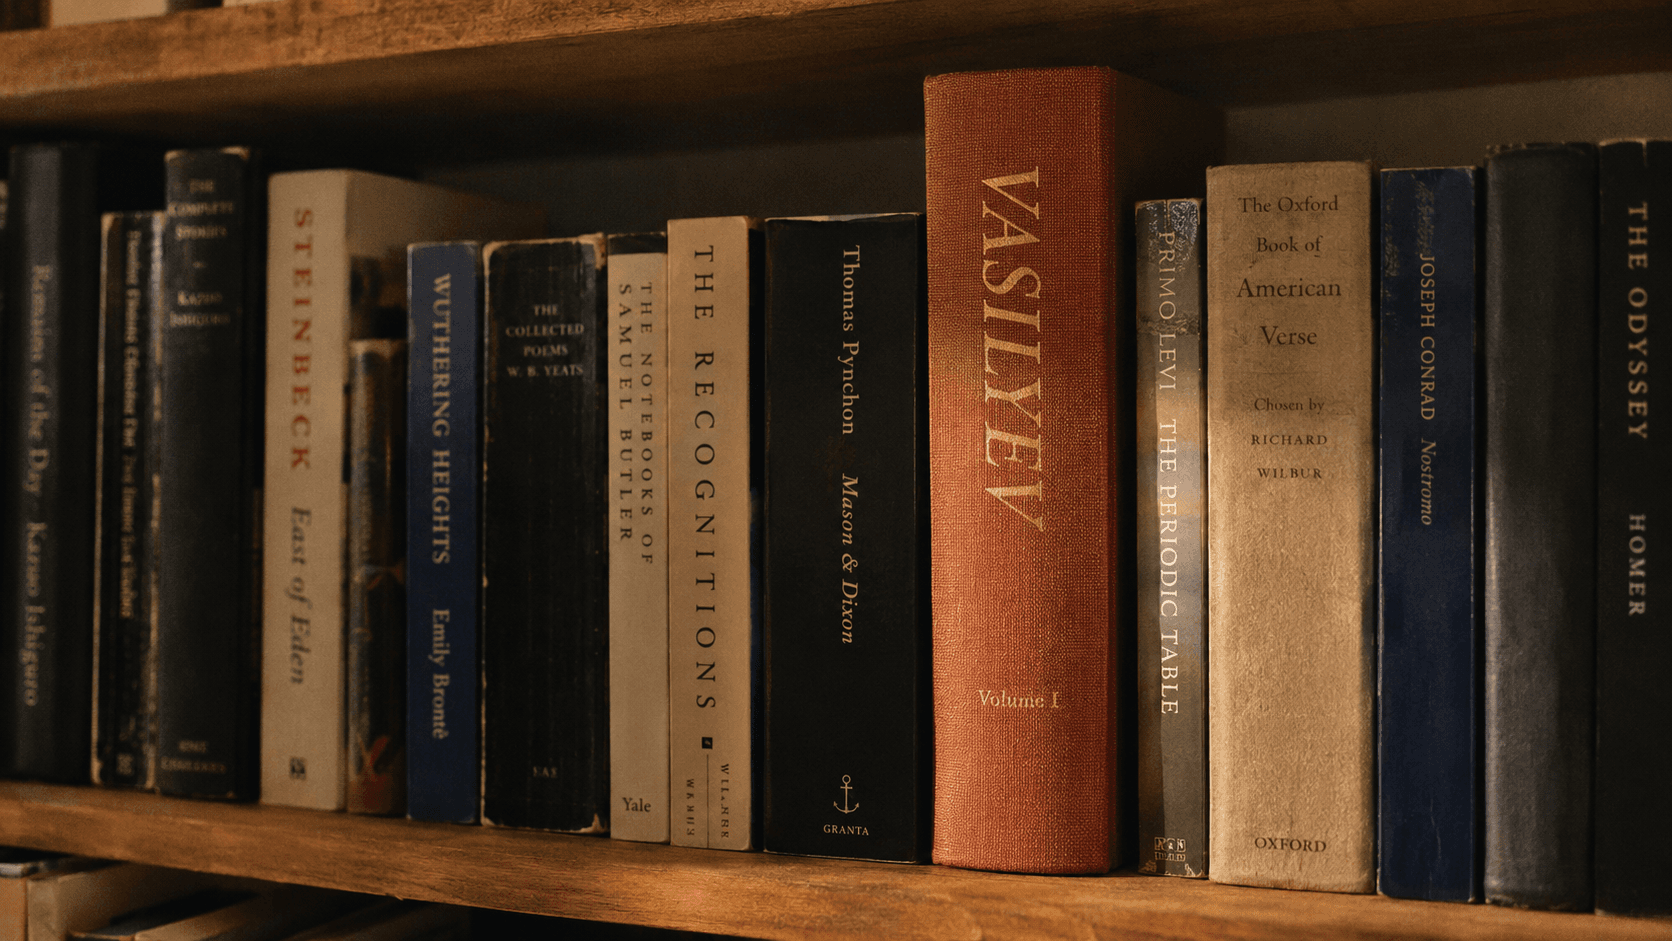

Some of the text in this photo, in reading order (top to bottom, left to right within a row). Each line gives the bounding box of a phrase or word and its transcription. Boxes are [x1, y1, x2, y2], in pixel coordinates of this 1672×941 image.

[1237, 195, 1339, 213] The Oxford
[1256, 236, 1323, 252] Book of
[1237, 278, 1342, 298] American
[533, 304, 559, 316] THE
[1158, 230, 1176, 390] PRIMO LEVI
[1627, 203, 1650, 440] THE ODYSSEY
[505, 323, 585, 337] COLLECTED
[837, 245, 861, 435] Thomas Pynchon
[982, 166, 1044, 532] VASILYEV
[1260, 325, 1317, 345] Verse
[1420, 254, 1435, 421] JOSEPH CONRAD
[523, 344, 568, 357] POEMS
[543, 364, 584, 377] YEATS
[431, 273, 451, 565] WUTHERING HEIGHTS
[619, 284, 633, 541] SAMUEL BUTLER
[641, 282, 653, 564] THE NOTEBOOKS OF
[1254, 397, 1325, 415] Chosen by
[286, 208, 313, 686] STEINBECK East of Eden
[1251, 434, 1328, 446] RICHARD
[694, 245, 716, 709] THE RECOGNITIONS
[1257, 467, 1322, 479] WILBUR
[1420, 438, 1436, 527] Nostromo
[841, 473, 859, 644] Mason & Dixon
[1160, 418, 1179, 714] THE PERIODIC TABLE
[1628, 513, 1649, 618] HOMER
[427, 609, 450, 666] Emily
[978, 689, 1060, 709] Volume I
[622, 797, 651, 813] Yale
[823, 824, 869, 836] GRANTA
[1254, 836, 1327, 853] OXFORD
